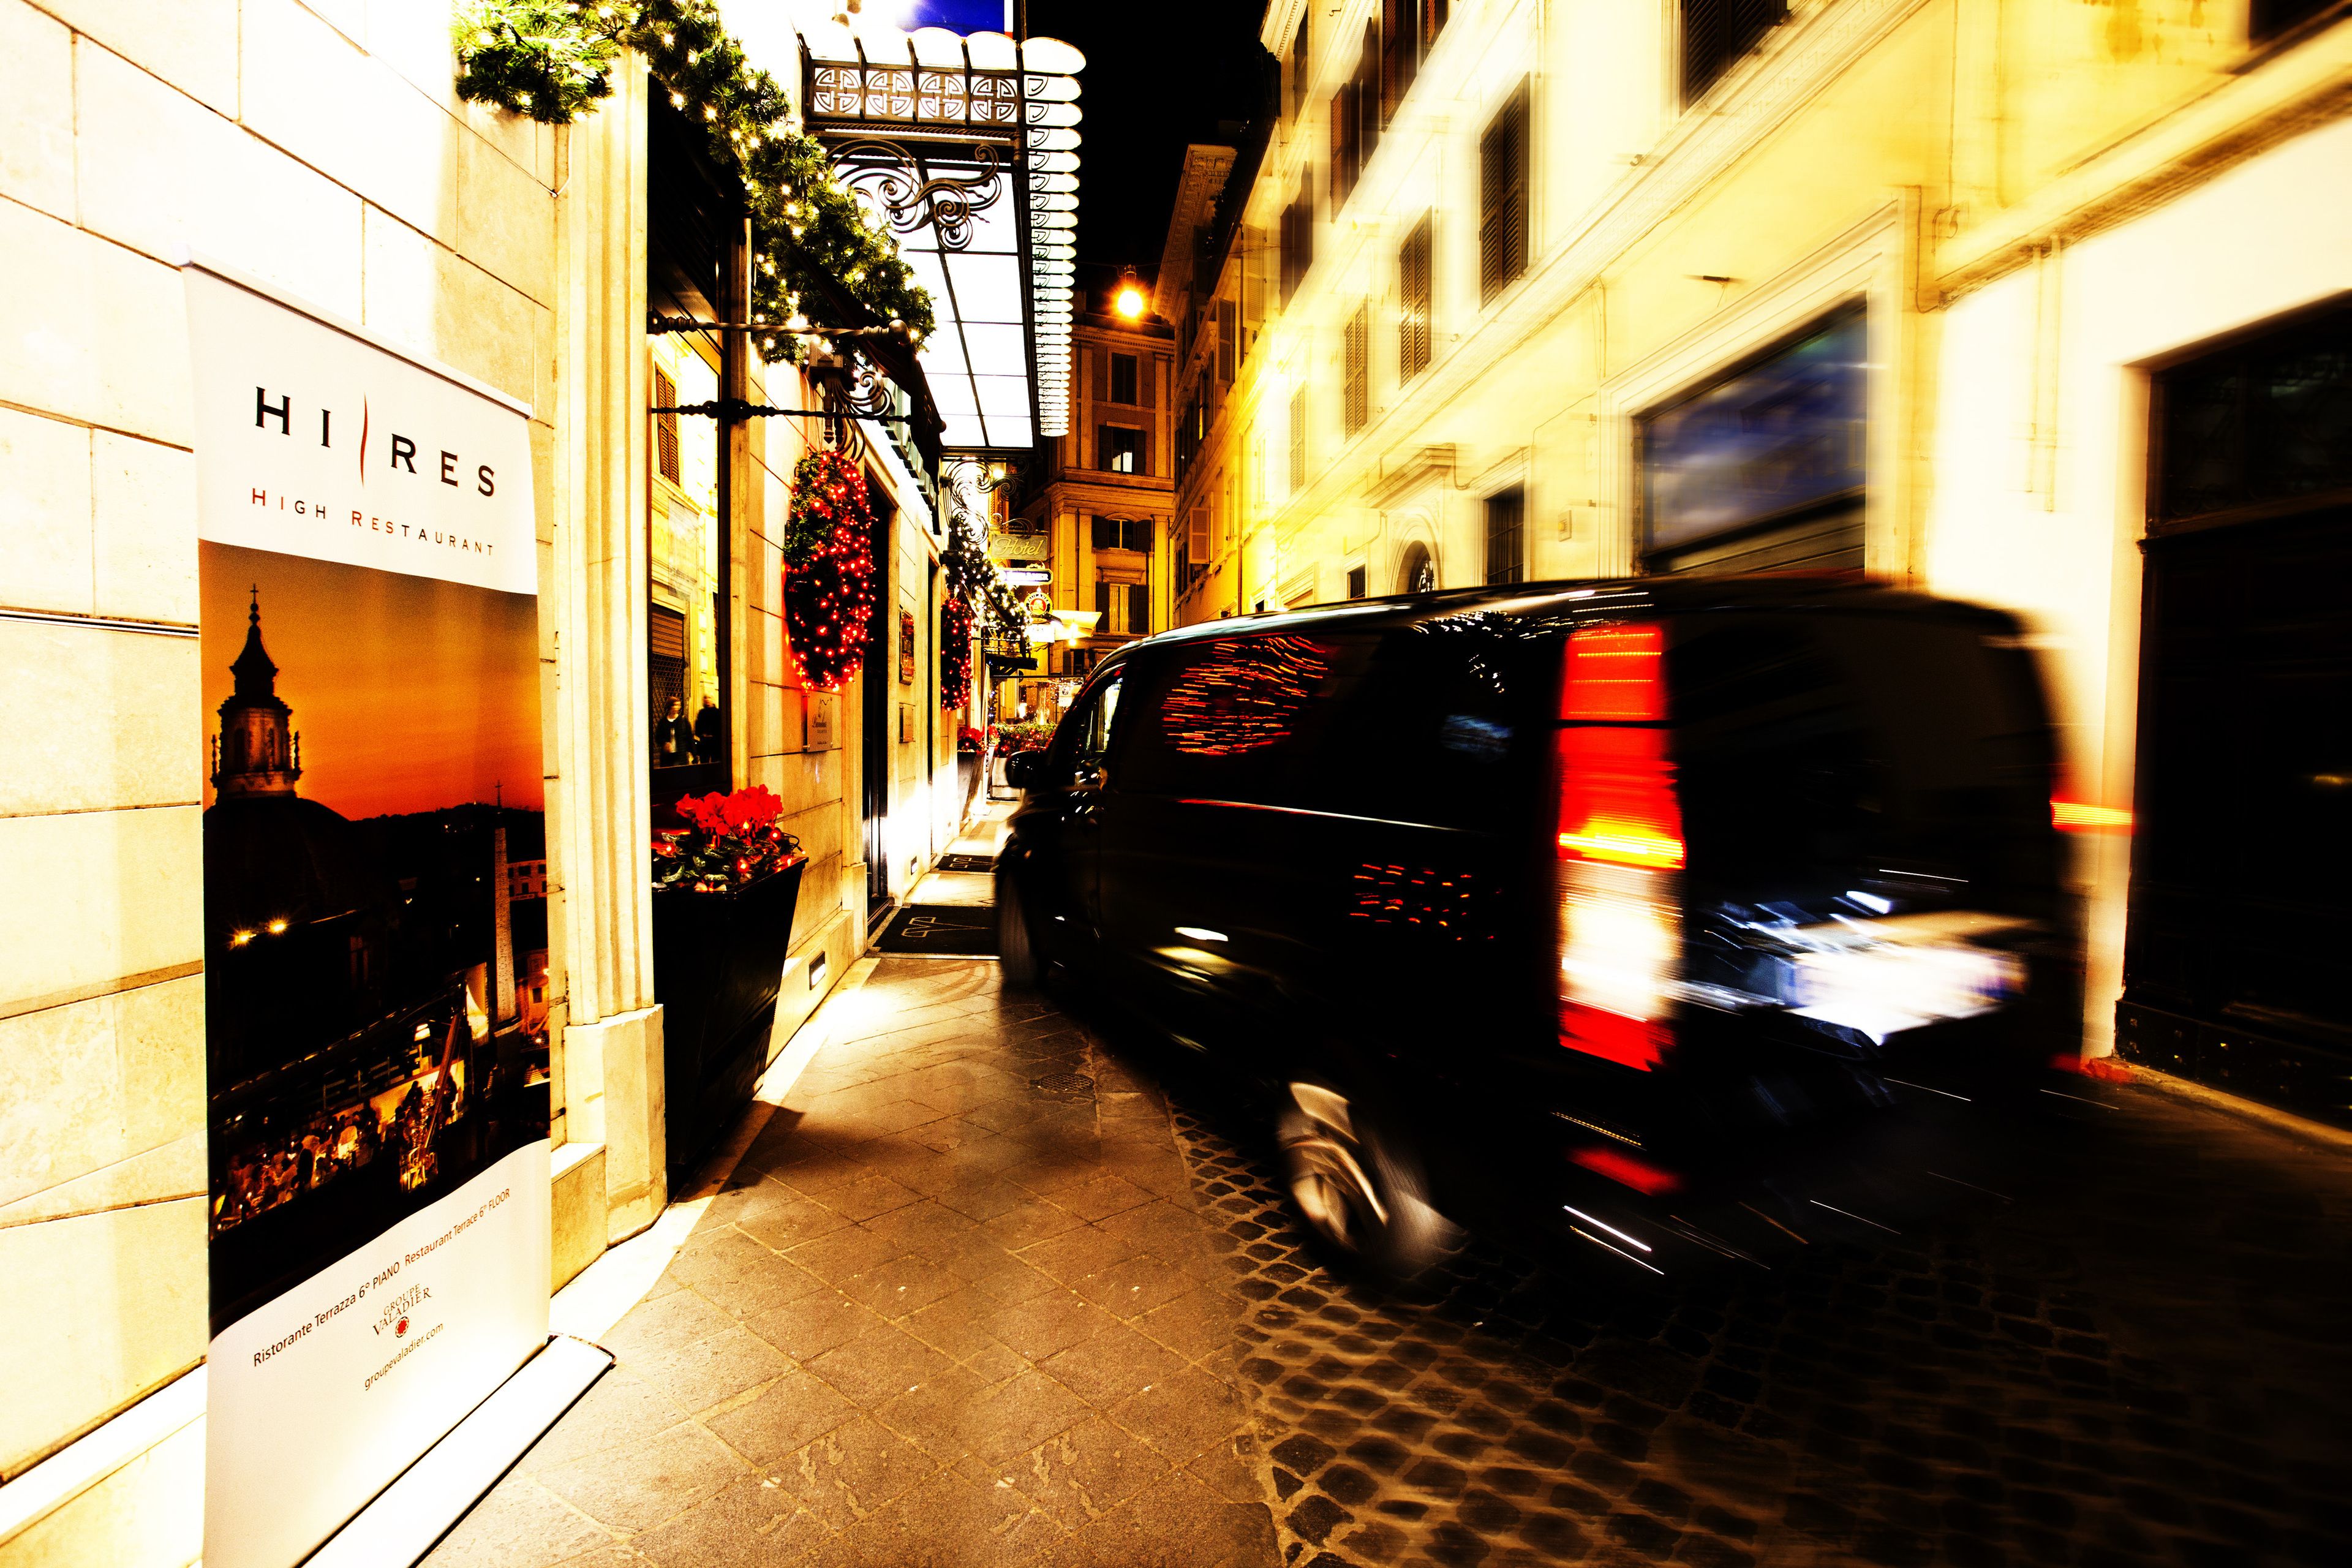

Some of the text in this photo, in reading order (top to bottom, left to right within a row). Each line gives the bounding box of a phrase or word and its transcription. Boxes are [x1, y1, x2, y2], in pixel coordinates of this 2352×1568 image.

[252, 488, 326, 519] HIGH
[994, 537, 1044, 556] Hotel
[254, 1322, 312, 1367] Ristorante
[314, 1294, 356, 1327] Terrazza
[372, 1262, 400, 1289] PIANO
[405, 1231, 452, 1267] Restaurant
[453, 1213, 478, 1235] Terrace
[488, 1188, 510, 1211] FLOOR
[372, 1287, 432, 1336] VALADIER
[383, 1283, 420, 1316] GROUPE
[364, 1322, 443, 1391] groupevaladier.com
